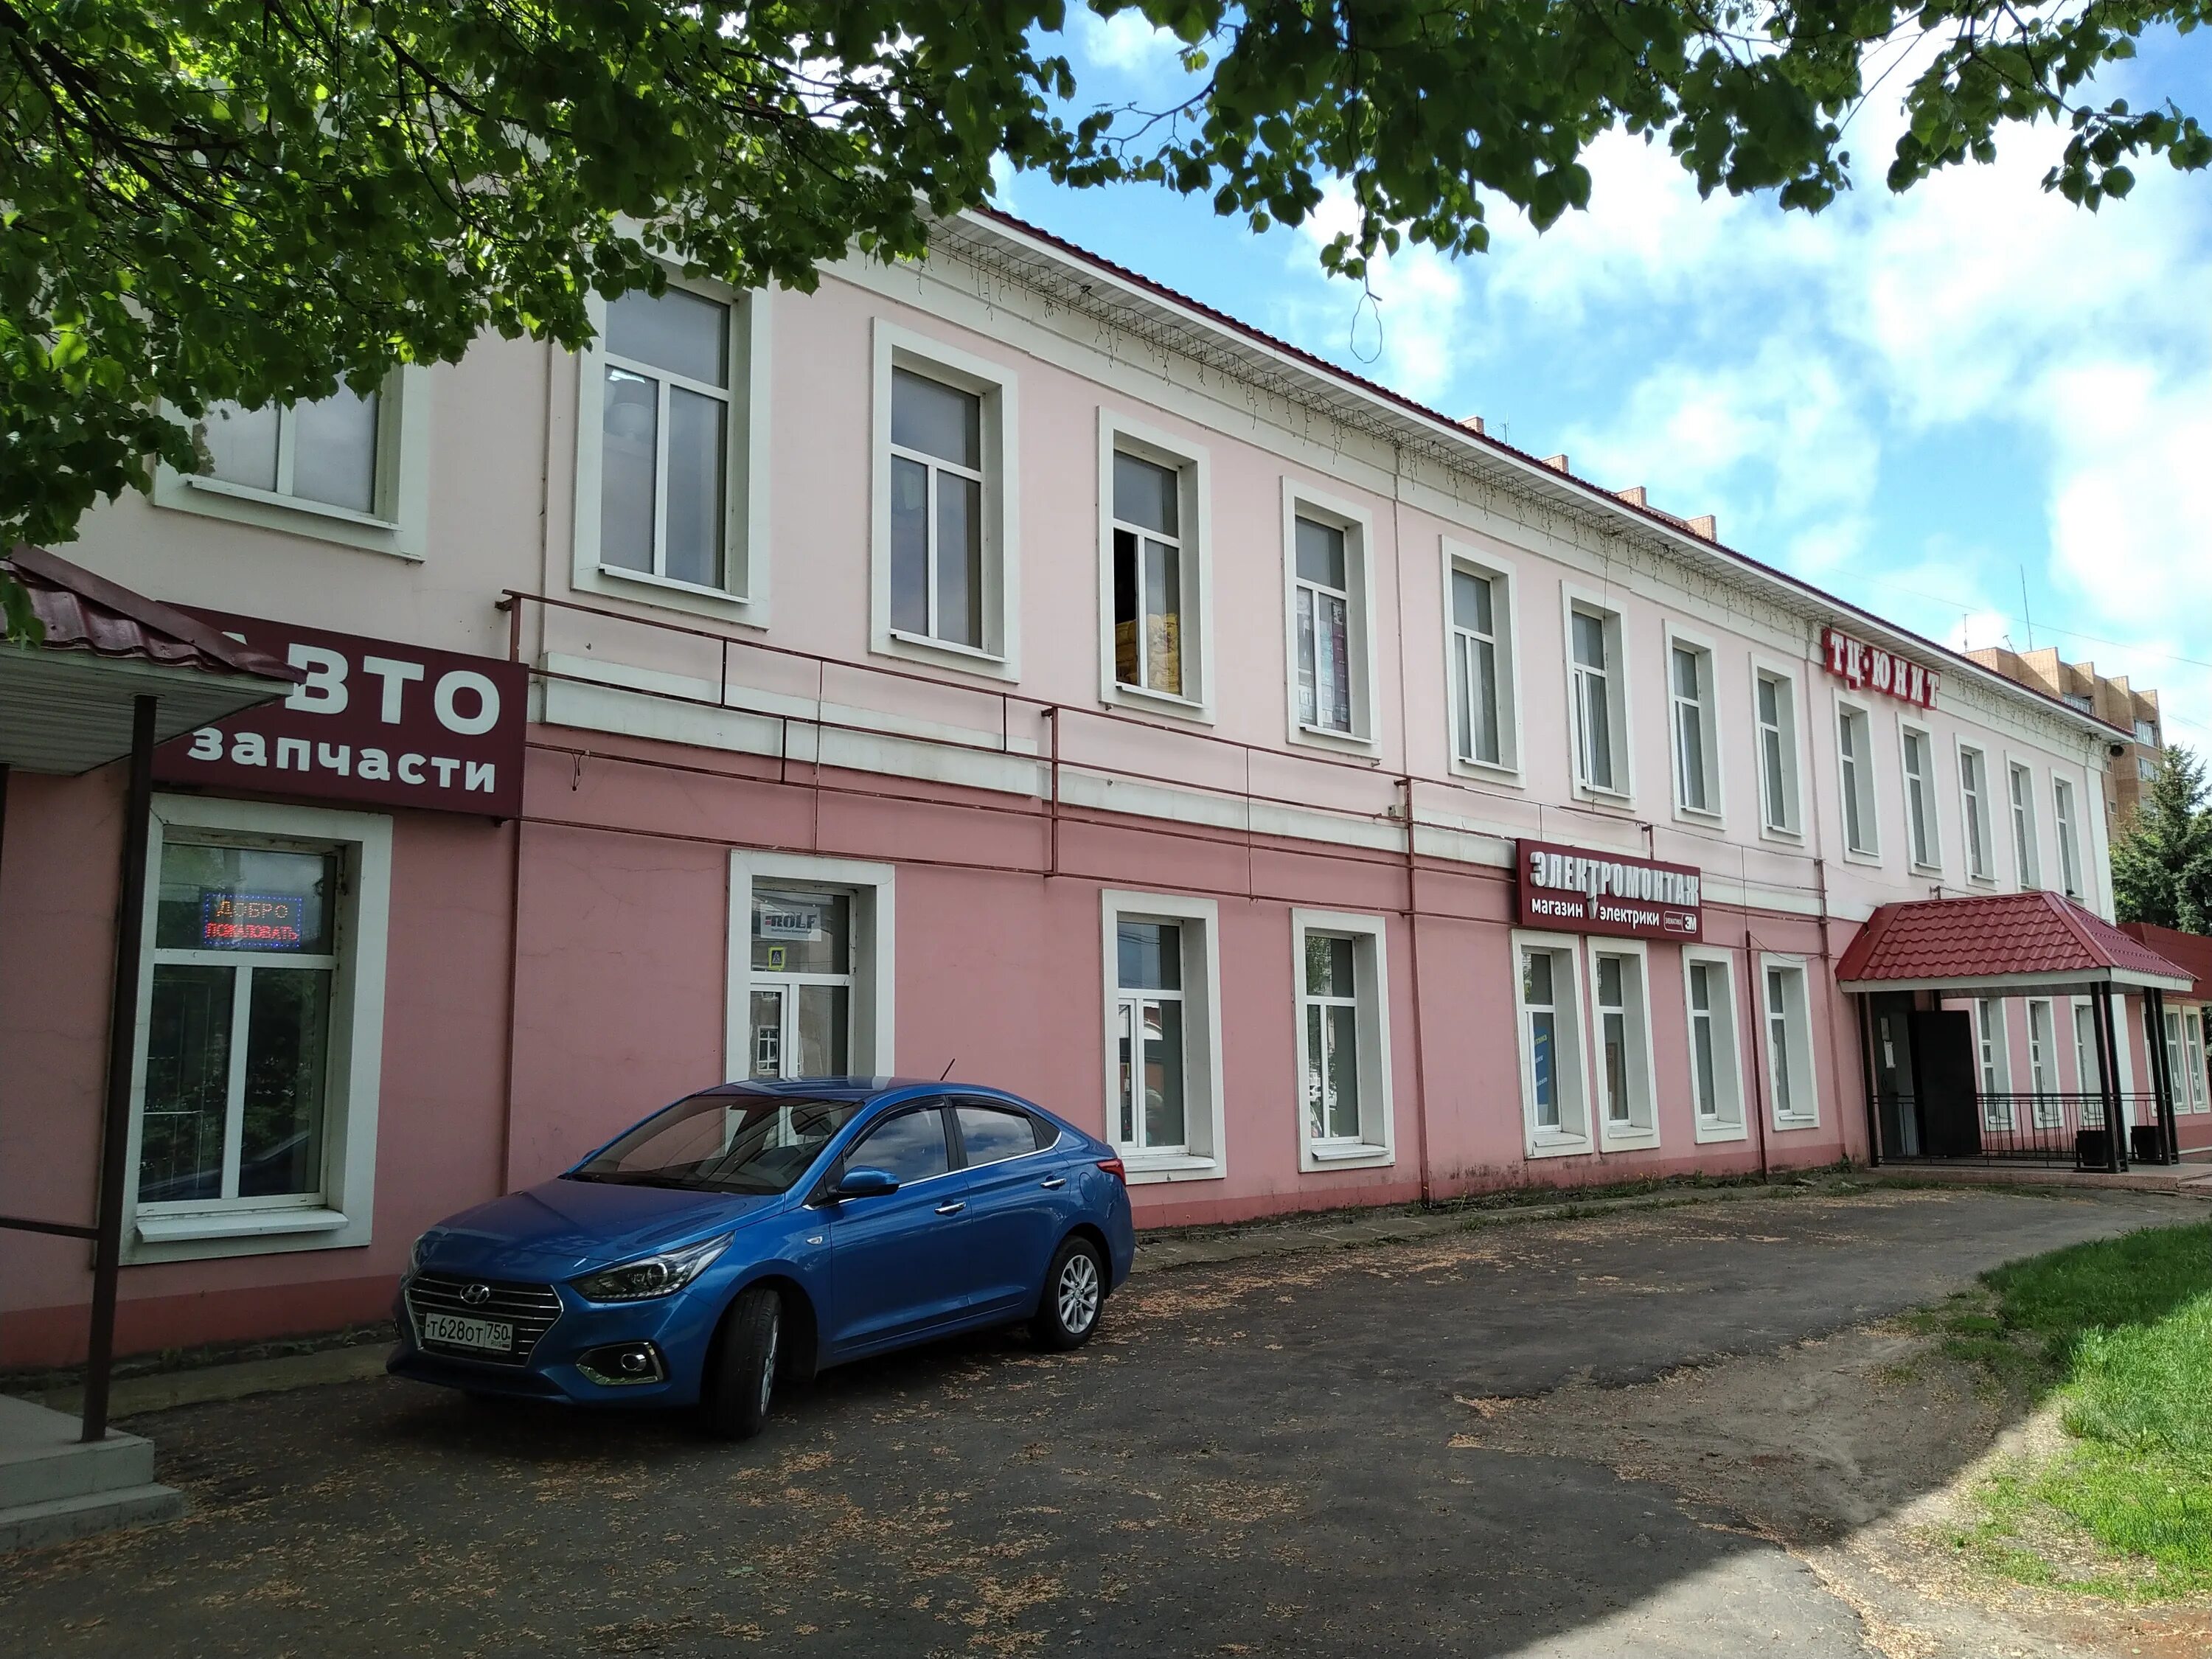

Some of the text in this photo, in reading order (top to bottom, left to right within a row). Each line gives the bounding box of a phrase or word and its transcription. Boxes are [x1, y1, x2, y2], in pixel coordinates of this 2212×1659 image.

[223, 631, 501, 736] ВТО
[187, 726, 496, 793] запчасти
[1530, 852, 1699, 907] ЭЛЕКТРОМОНТАЖ
[215, 899, 288, 919] ДОБРО
[771, 911, 818, 929] ROLF
[1531, 898, 1659, 929] магазин электрики
[205, 922, 299, 941] ПОЖАЛОВАТЬ
